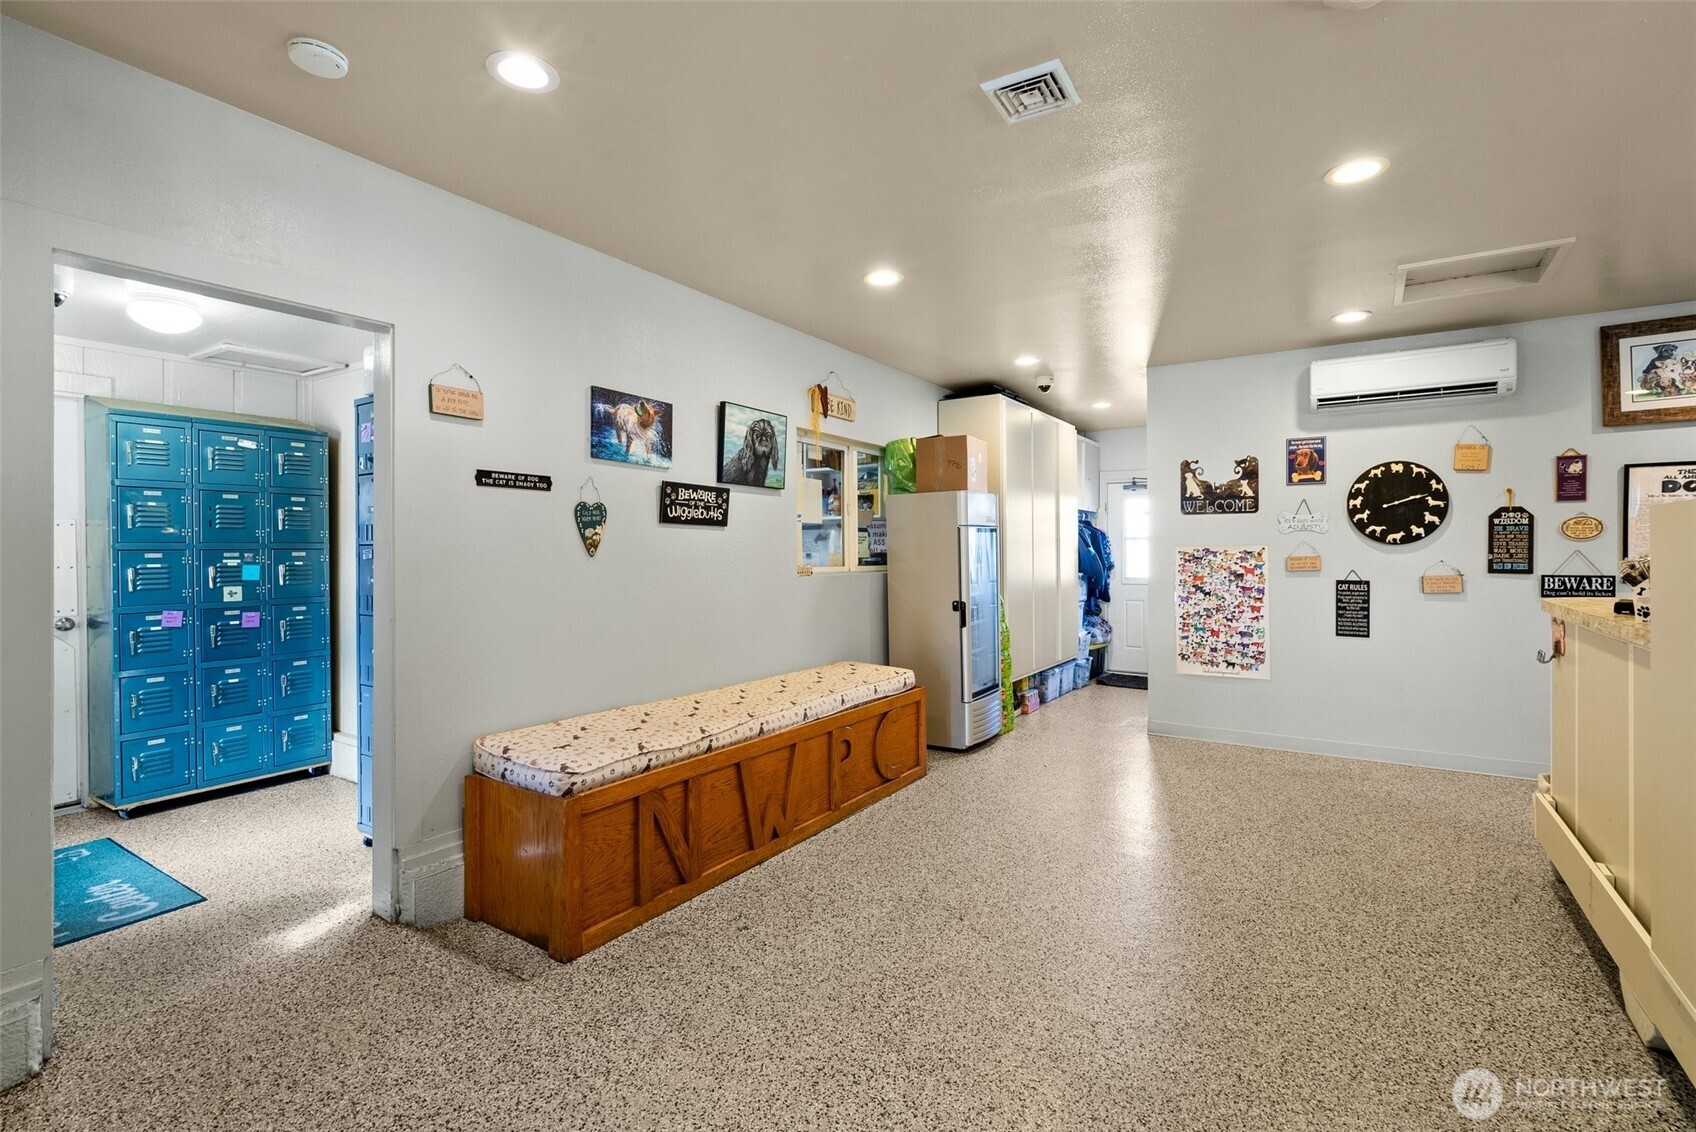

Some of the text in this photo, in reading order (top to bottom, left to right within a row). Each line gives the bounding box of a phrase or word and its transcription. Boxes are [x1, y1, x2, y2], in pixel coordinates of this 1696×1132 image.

[836, 400, 853, 418] KIND
[1182, 499, 1256, 513] WELCOME
[1543, 576, 1614, 591] BEWARE
